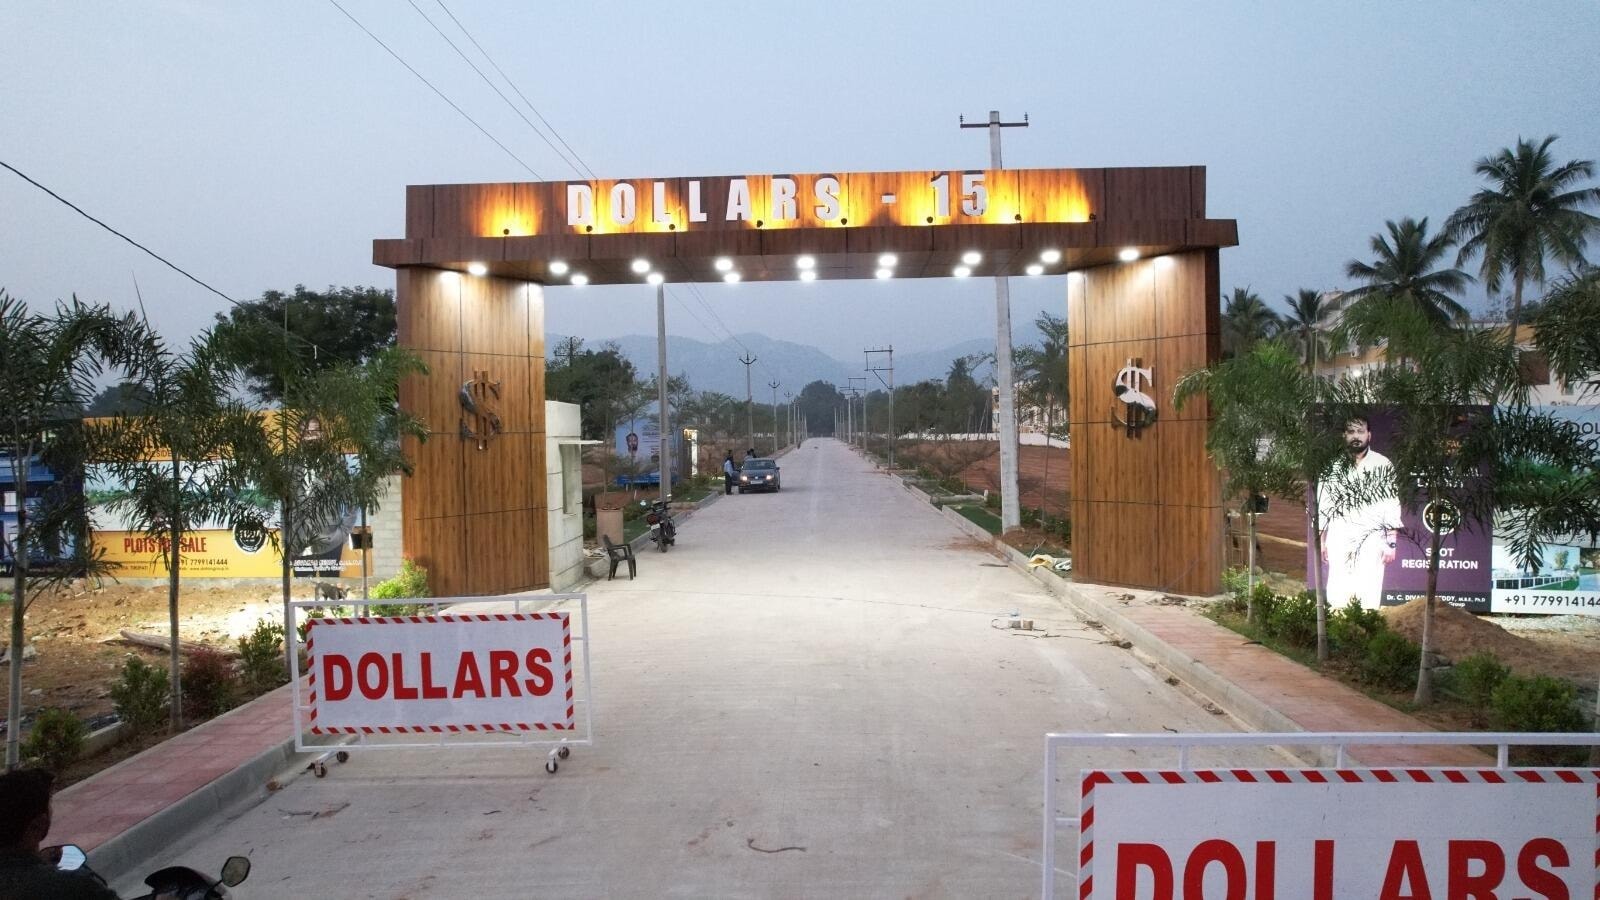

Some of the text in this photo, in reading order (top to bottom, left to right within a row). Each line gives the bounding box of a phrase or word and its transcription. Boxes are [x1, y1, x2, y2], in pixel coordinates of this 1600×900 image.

[567, 176, 841, 226] DOLLARS
[930, 174, 988, 217] 15
[124, 537, 155, 553] PLOTS
[181, 537, 207, 553] SALE
[1425, 547, 1455, 557] SOT
[1401, 559, 1479, 570] REGISRATION
[1504, 595, 1526, 605] +91
[322, 647, 554, 702] DOLLARS
